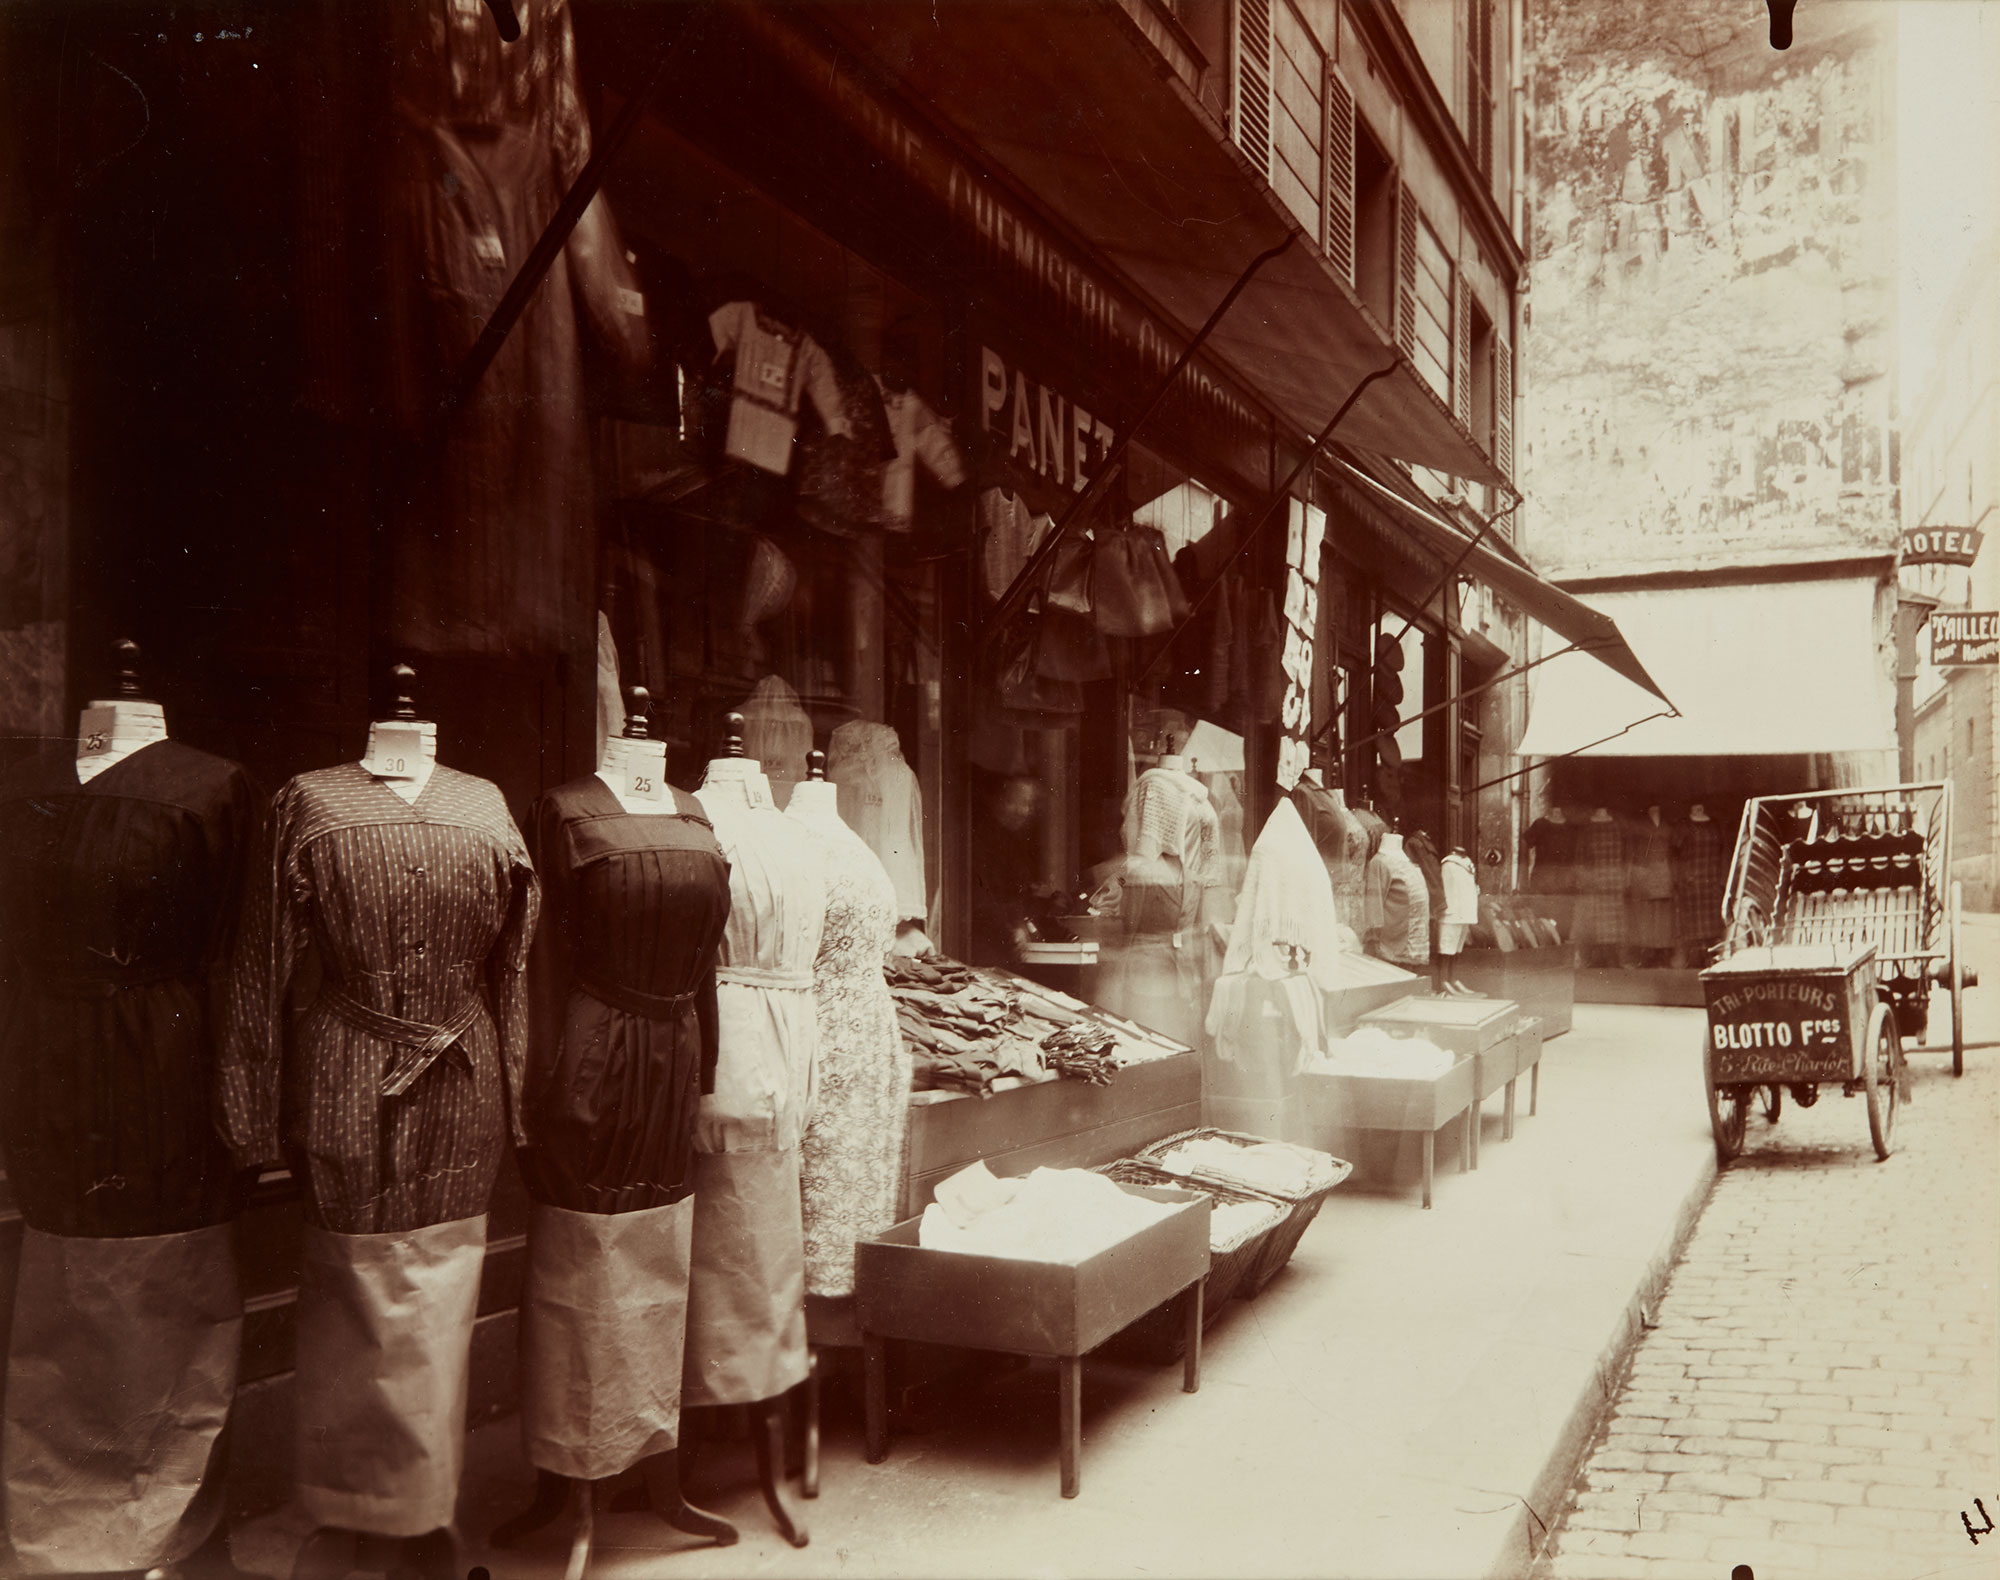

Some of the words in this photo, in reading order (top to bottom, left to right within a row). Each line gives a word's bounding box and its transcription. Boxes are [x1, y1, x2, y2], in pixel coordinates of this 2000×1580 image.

[385, 758, 405, 772] 30
[634, 776, 652, 793] 25
[1712, 983, 1837, 1015] TRI-PORTEURS
[1713, 1021, 1792, 1050] BLOTTO
